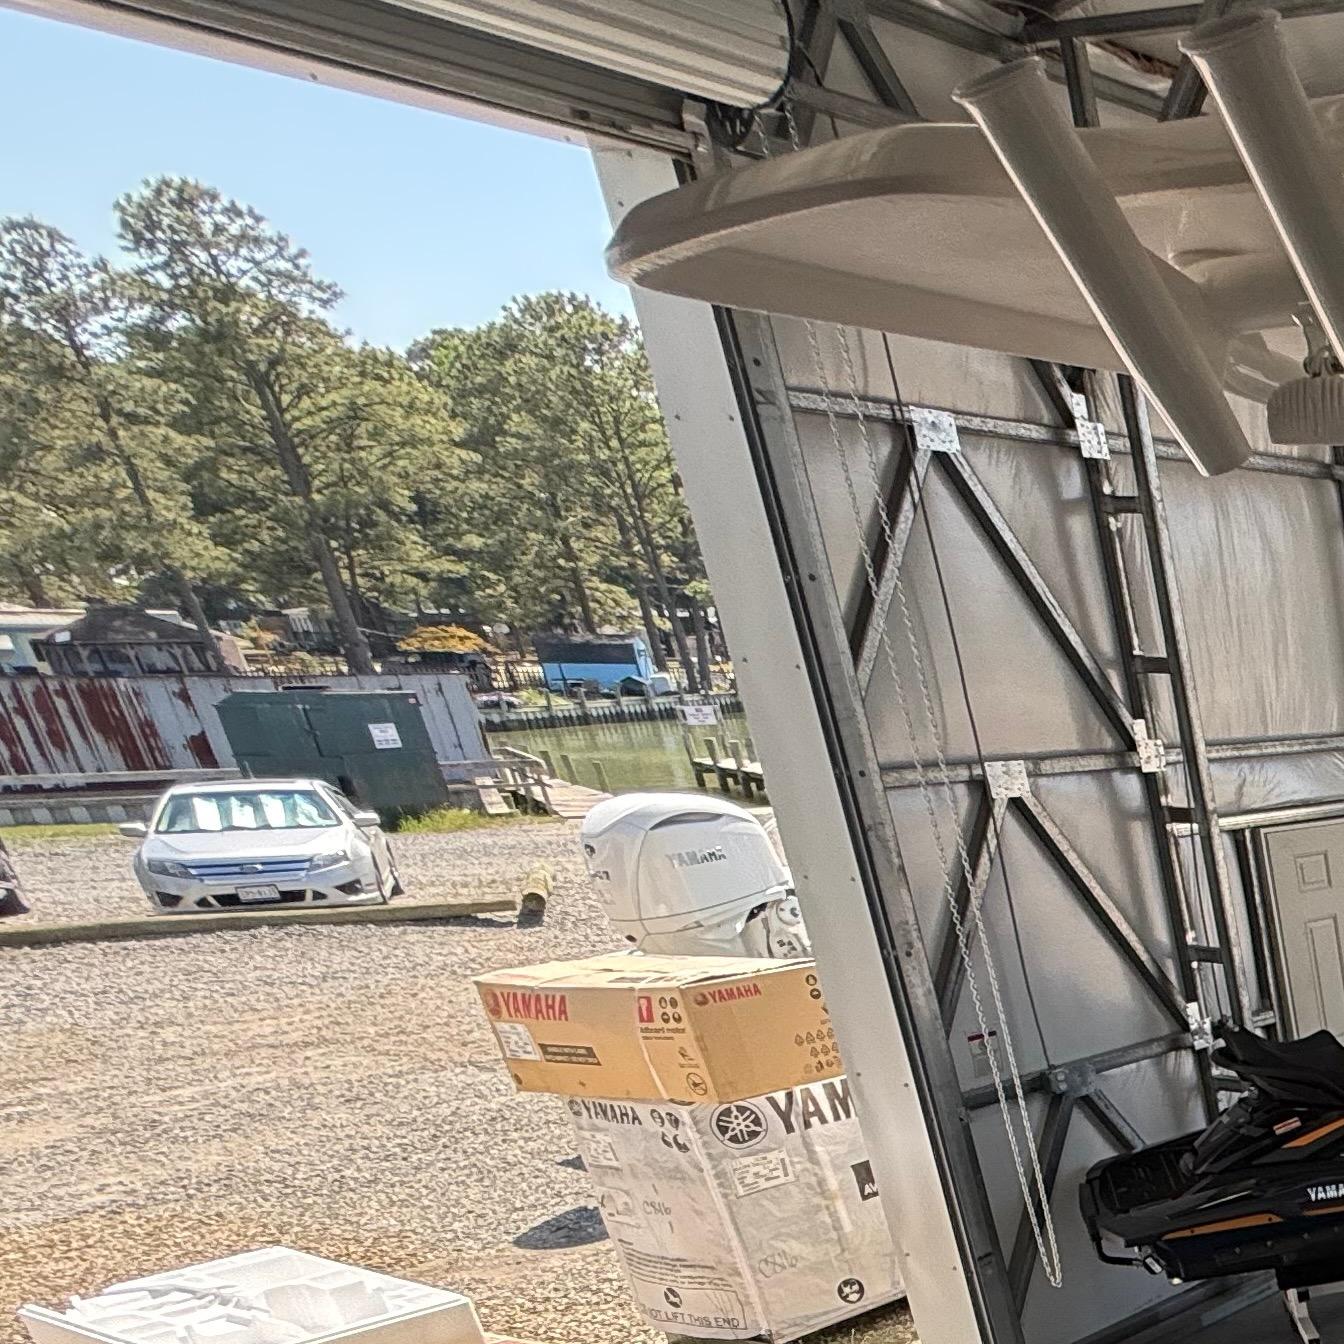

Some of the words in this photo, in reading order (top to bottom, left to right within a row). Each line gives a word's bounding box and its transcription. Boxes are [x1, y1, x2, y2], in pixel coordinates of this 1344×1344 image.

[708, 983, 762, 1004] YAMAHA
[500, 992, 569, 1022] YAMAHA
[581, 1100, 643, 1126] YAMAHA
[666, 1310, 686, 1323] LIFT
[688, 1313, 712, 1327] THIS
[714, 1316, 740, 1328] END
